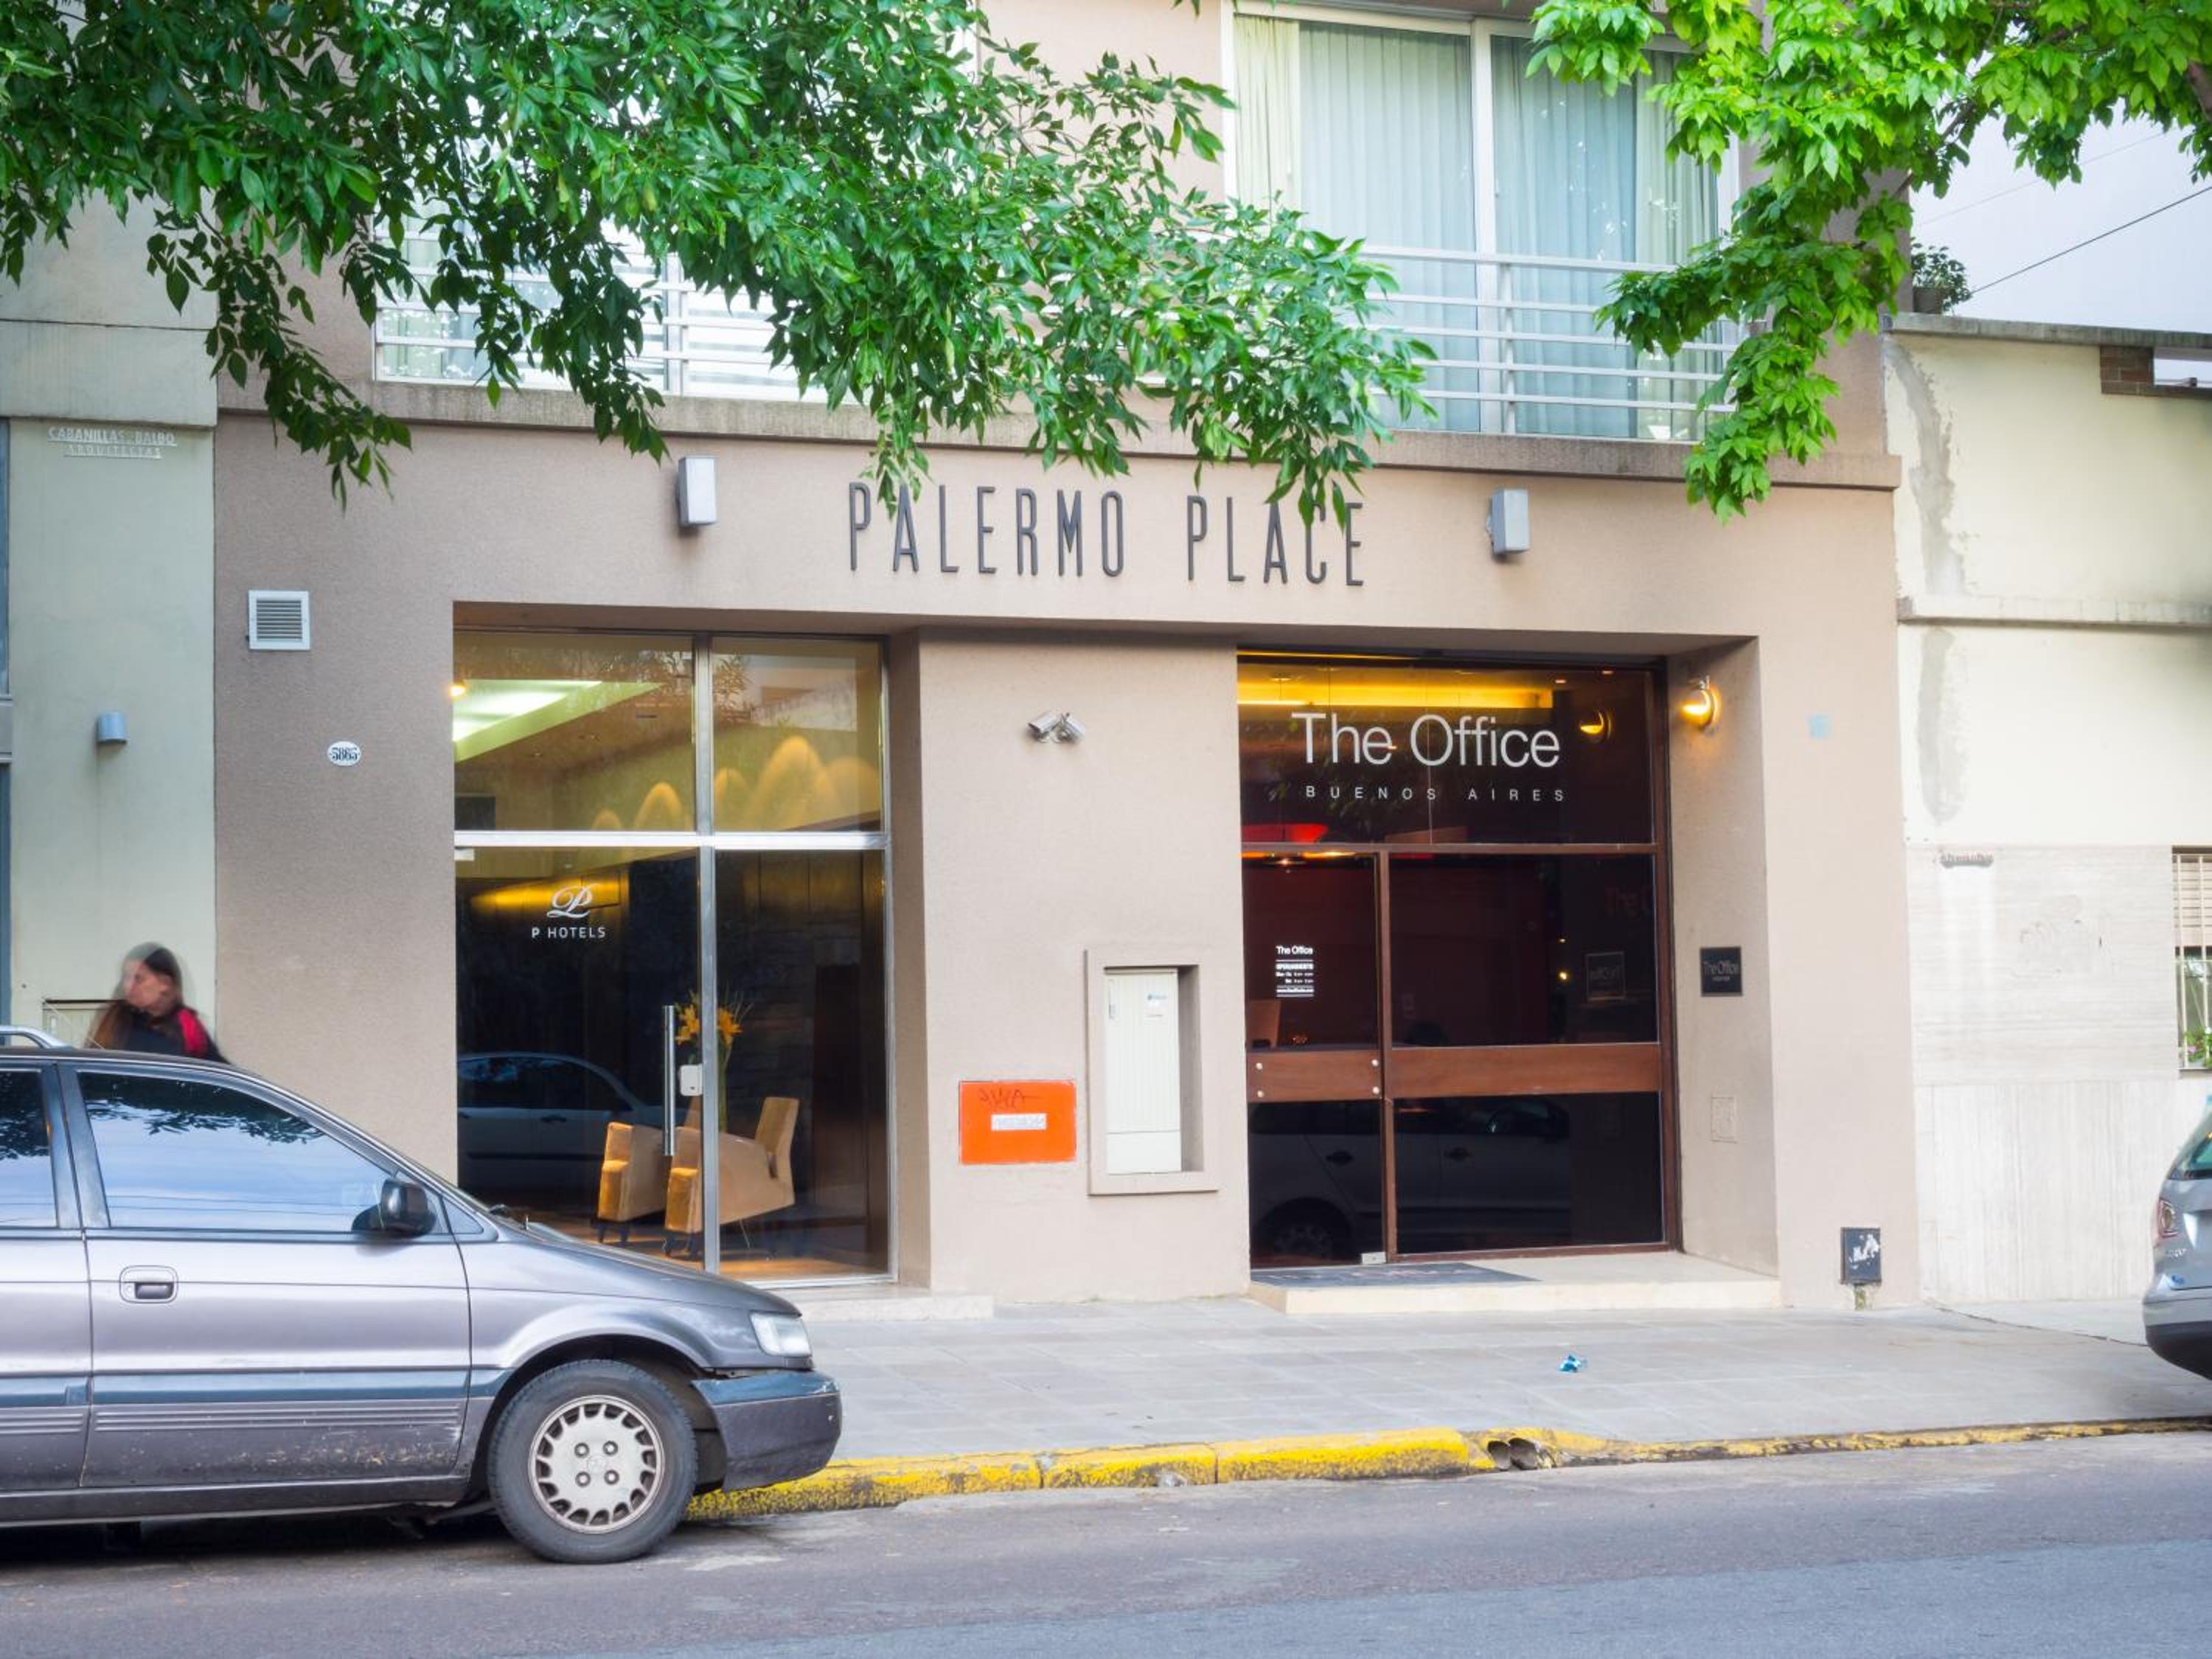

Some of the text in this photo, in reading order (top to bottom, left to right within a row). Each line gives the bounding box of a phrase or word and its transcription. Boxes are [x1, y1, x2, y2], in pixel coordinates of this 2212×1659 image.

[849, 481, 1364, 586] PALERMO PLACE
[1291, 712, 1560, 768] The Office
[1306, 785, 1564, 802] BUENOS AIRES
[532, 927, 606, 939] P HOTELS
